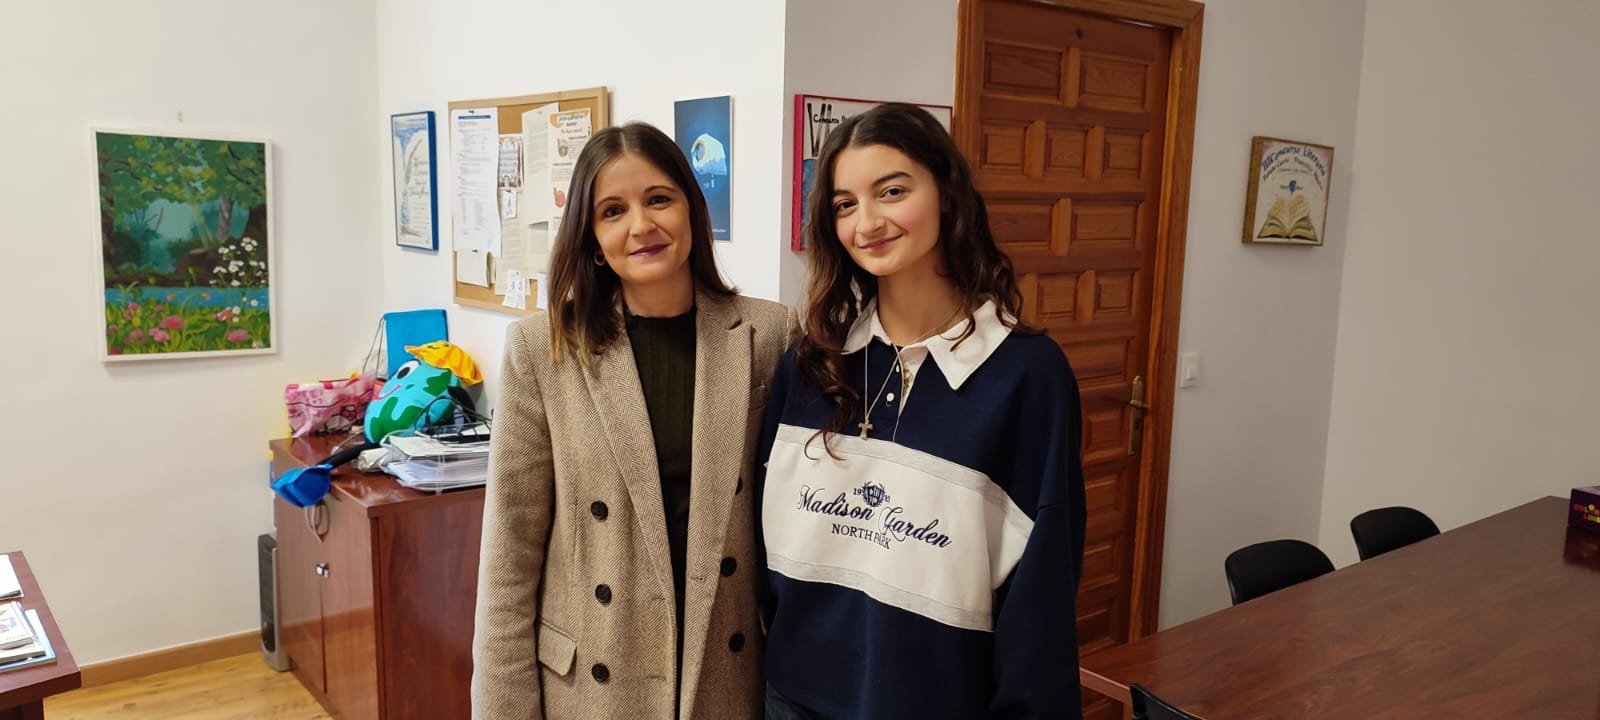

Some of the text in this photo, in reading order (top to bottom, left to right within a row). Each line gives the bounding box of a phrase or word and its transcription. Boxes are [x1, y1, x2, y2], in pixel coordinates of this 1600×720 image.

[798, 485, 952, 548] Madison Garden
[831, 523, 892, 549] NORTH PARK
